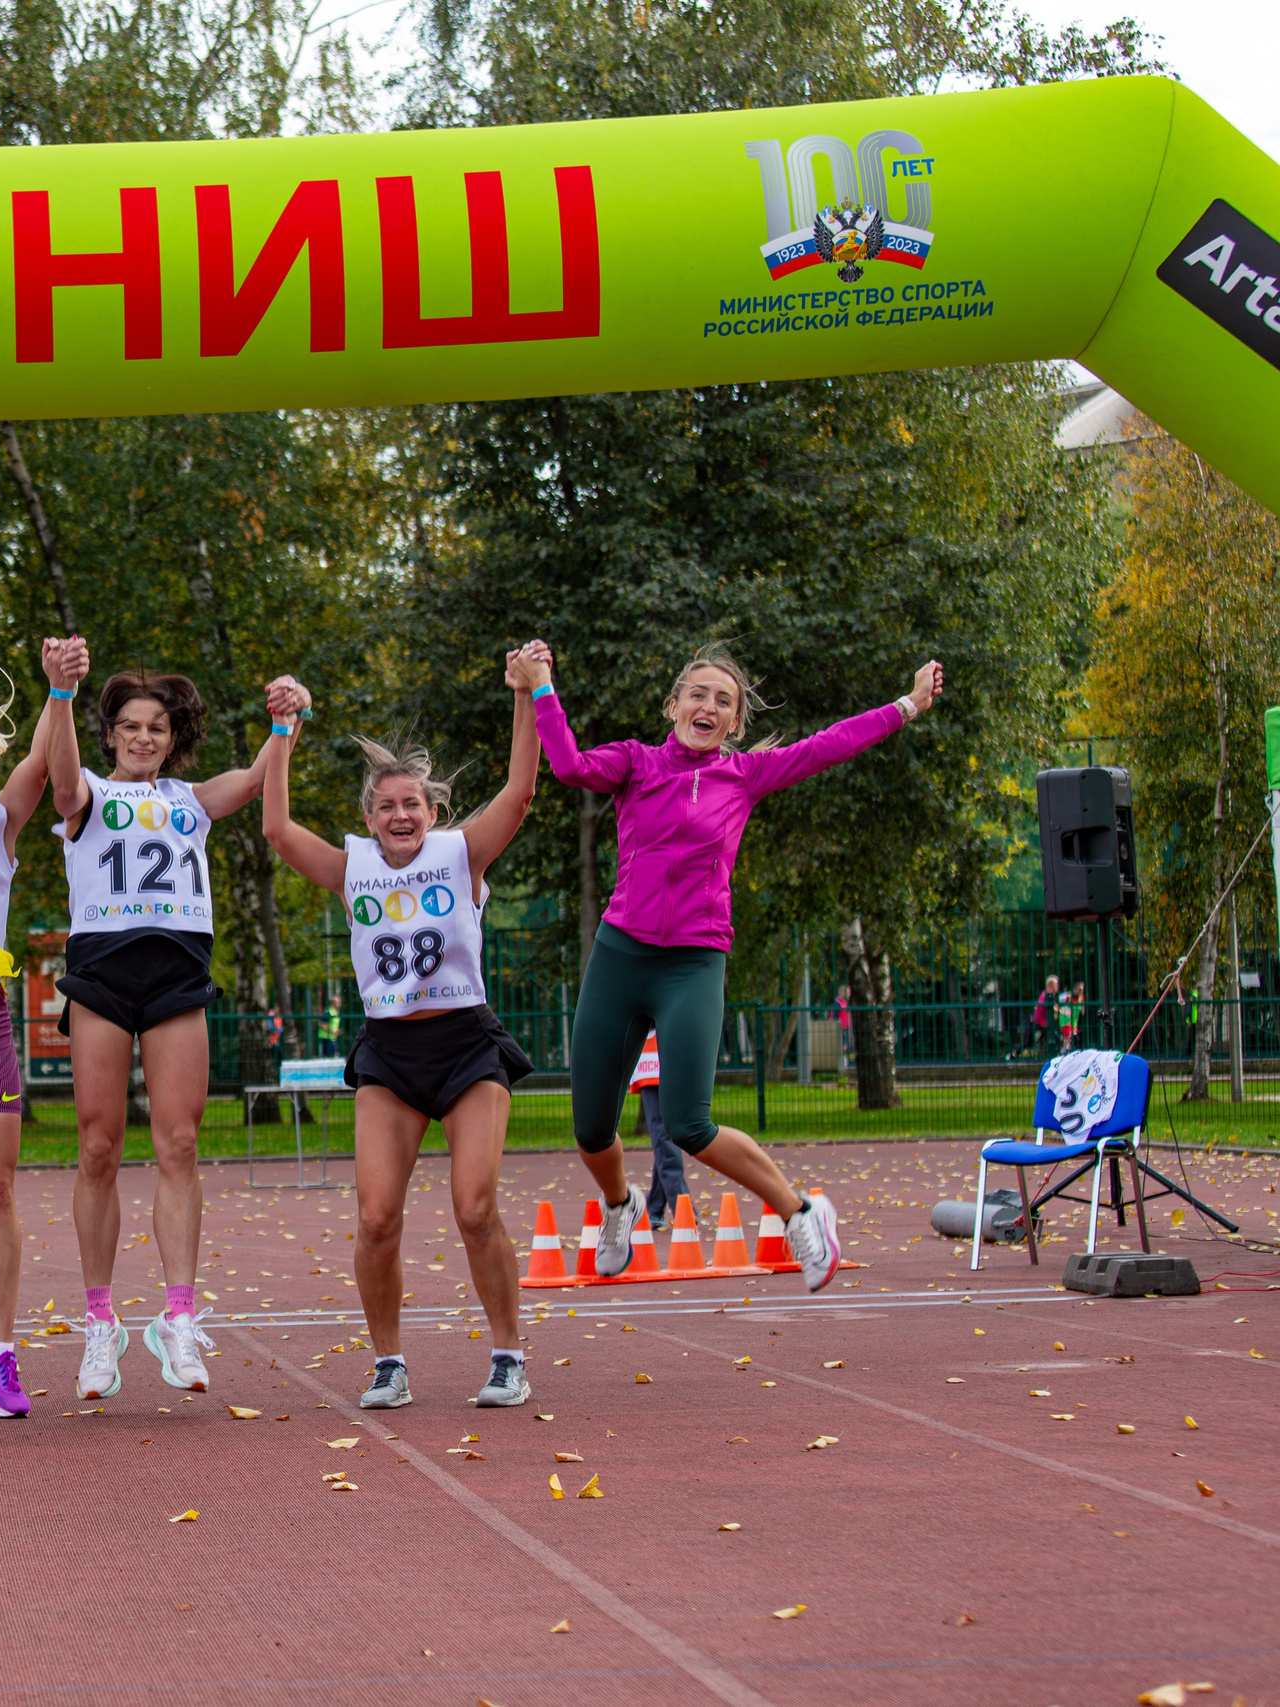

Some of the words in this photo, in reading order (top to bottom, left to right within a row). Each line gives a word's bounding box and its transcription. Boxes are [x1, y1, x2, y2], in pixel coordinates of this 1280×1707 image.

[891, 157, 936, 178] ЛЕТ
[775, 242, 807, 265] 1923
[886, 236, 922, 256] 2023
[719, 286, 896, 316] МИНИСТЕРСТВО
[901, 279, 987, 302] СПОРТА
[703, 307, 850, 338] РОССИЙСКОЙ
[855, 300, 995, 327] ФЕДЕРАЦИИ
[98, 838, 205, 898] 121
[349, 867, 451, 893] VMARAFONE
[372, 927, 445, 984] 88
